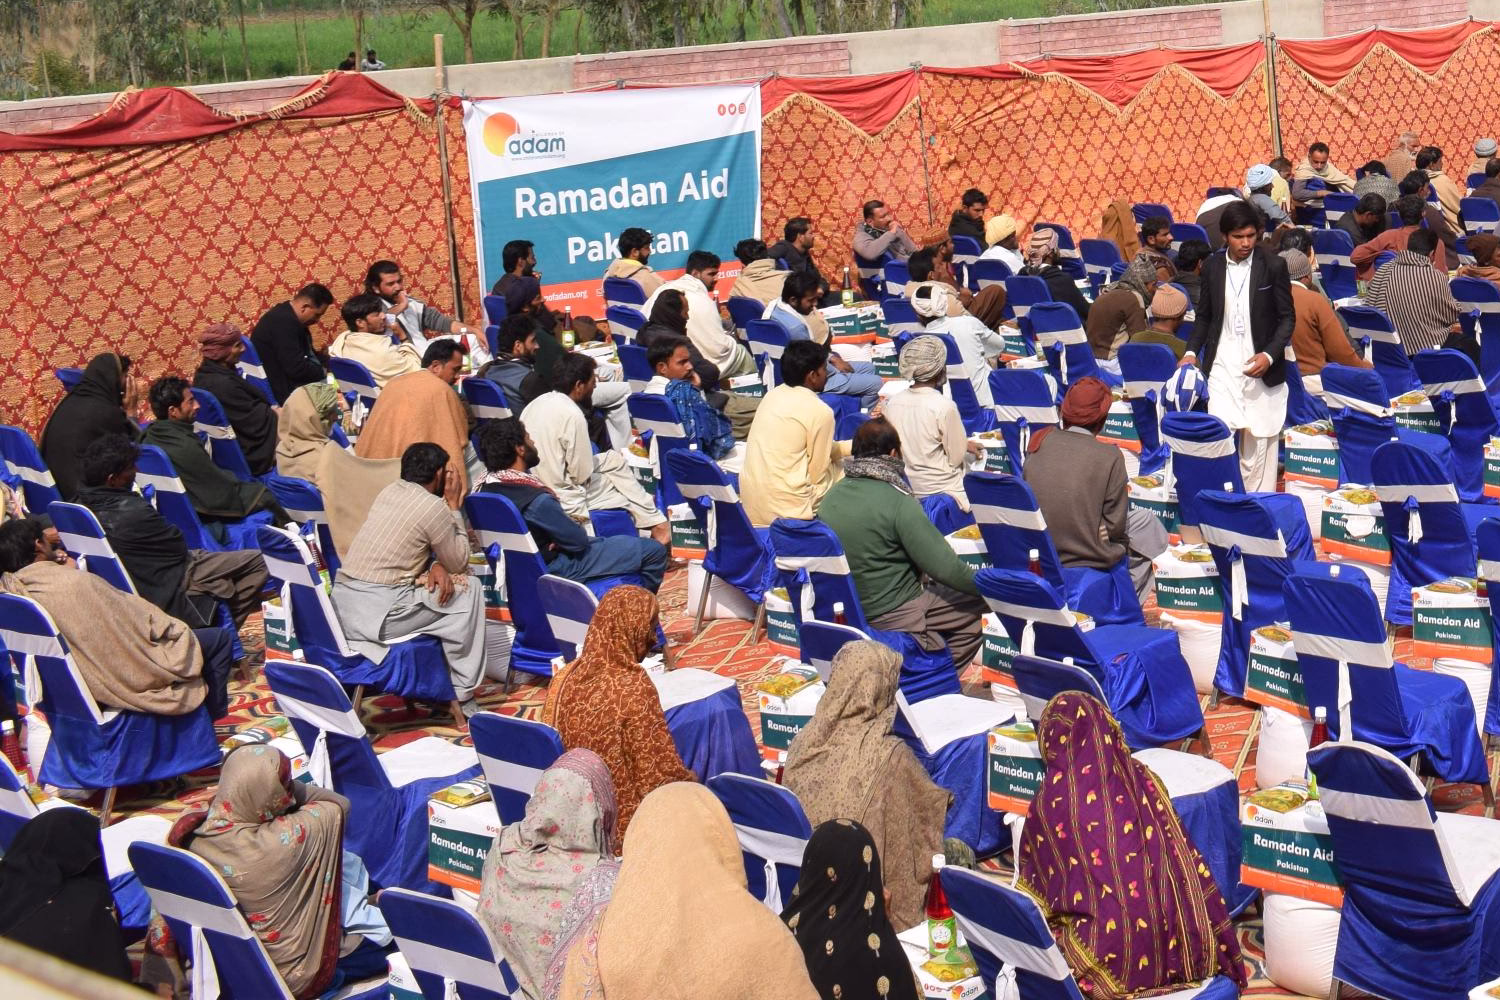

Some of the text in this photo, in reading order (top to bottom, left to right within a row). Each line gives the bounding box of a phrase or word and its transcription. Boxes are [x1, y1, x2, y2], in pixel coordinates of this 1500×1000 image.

[508, 137, 565, 155] adam
[515, 167, 729, 218] Ramadan Aid
[567, 230, 689, 264] Paktan
[1290, 452, 1336, 466] Ramadan Aid
[1162, 510, 1174, 519] Aid
[1158, 583, 1214, 595] Ramadan Aid
[1417, 613, 1480, 629] Ramadan Aid
[1435, 631, 1461, 640] Pakistan
[1251, 660, 1290, 680] Ramadan
[1266, 681, 1289, 695] Pakistan
[994, 761, 1046, 782] Ramadan Ai
[1010, 784, 1035, 796] Pakistan
[1254, 815, 1274, 826] adam
[431, 832, 486, 860] Ramadan Ai
[1253, 833, 1334, 862] Ramadan Aid
[448, 857, 474, 872] Pakistan
[1276, 860, 1309, 874] Pakistan
[961, 986, 979, 998] adam
